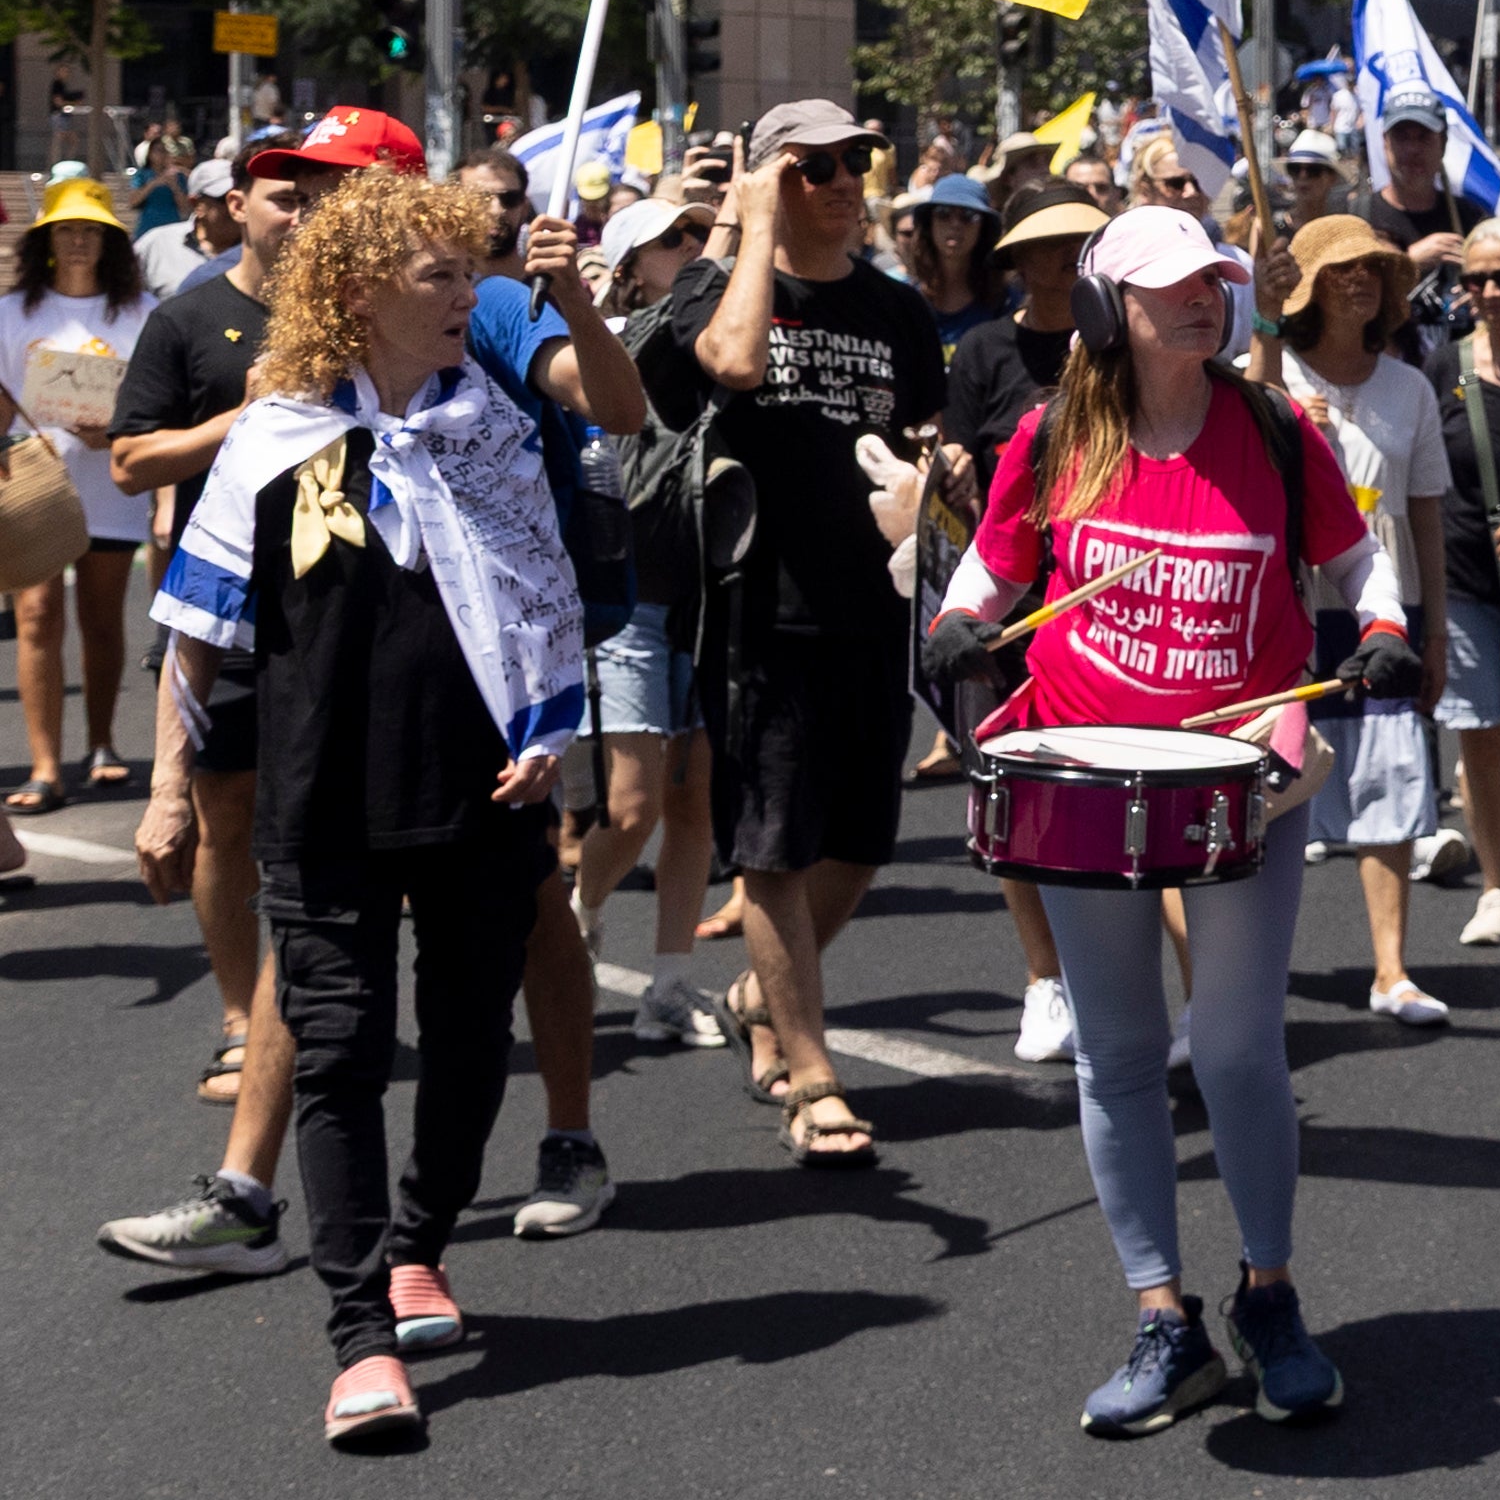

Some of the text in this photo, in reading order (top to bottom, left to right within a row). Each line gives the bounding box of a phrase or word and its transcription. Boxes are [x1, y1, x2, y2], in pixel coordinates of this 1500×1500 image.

[768, 326, 892, 360] ALESTINIAN
[813, 350, 895, 380] MATTER
[1084, 537, 1253, 605] PINKFRONT
[1163, 647, 1238, 681] החזית
